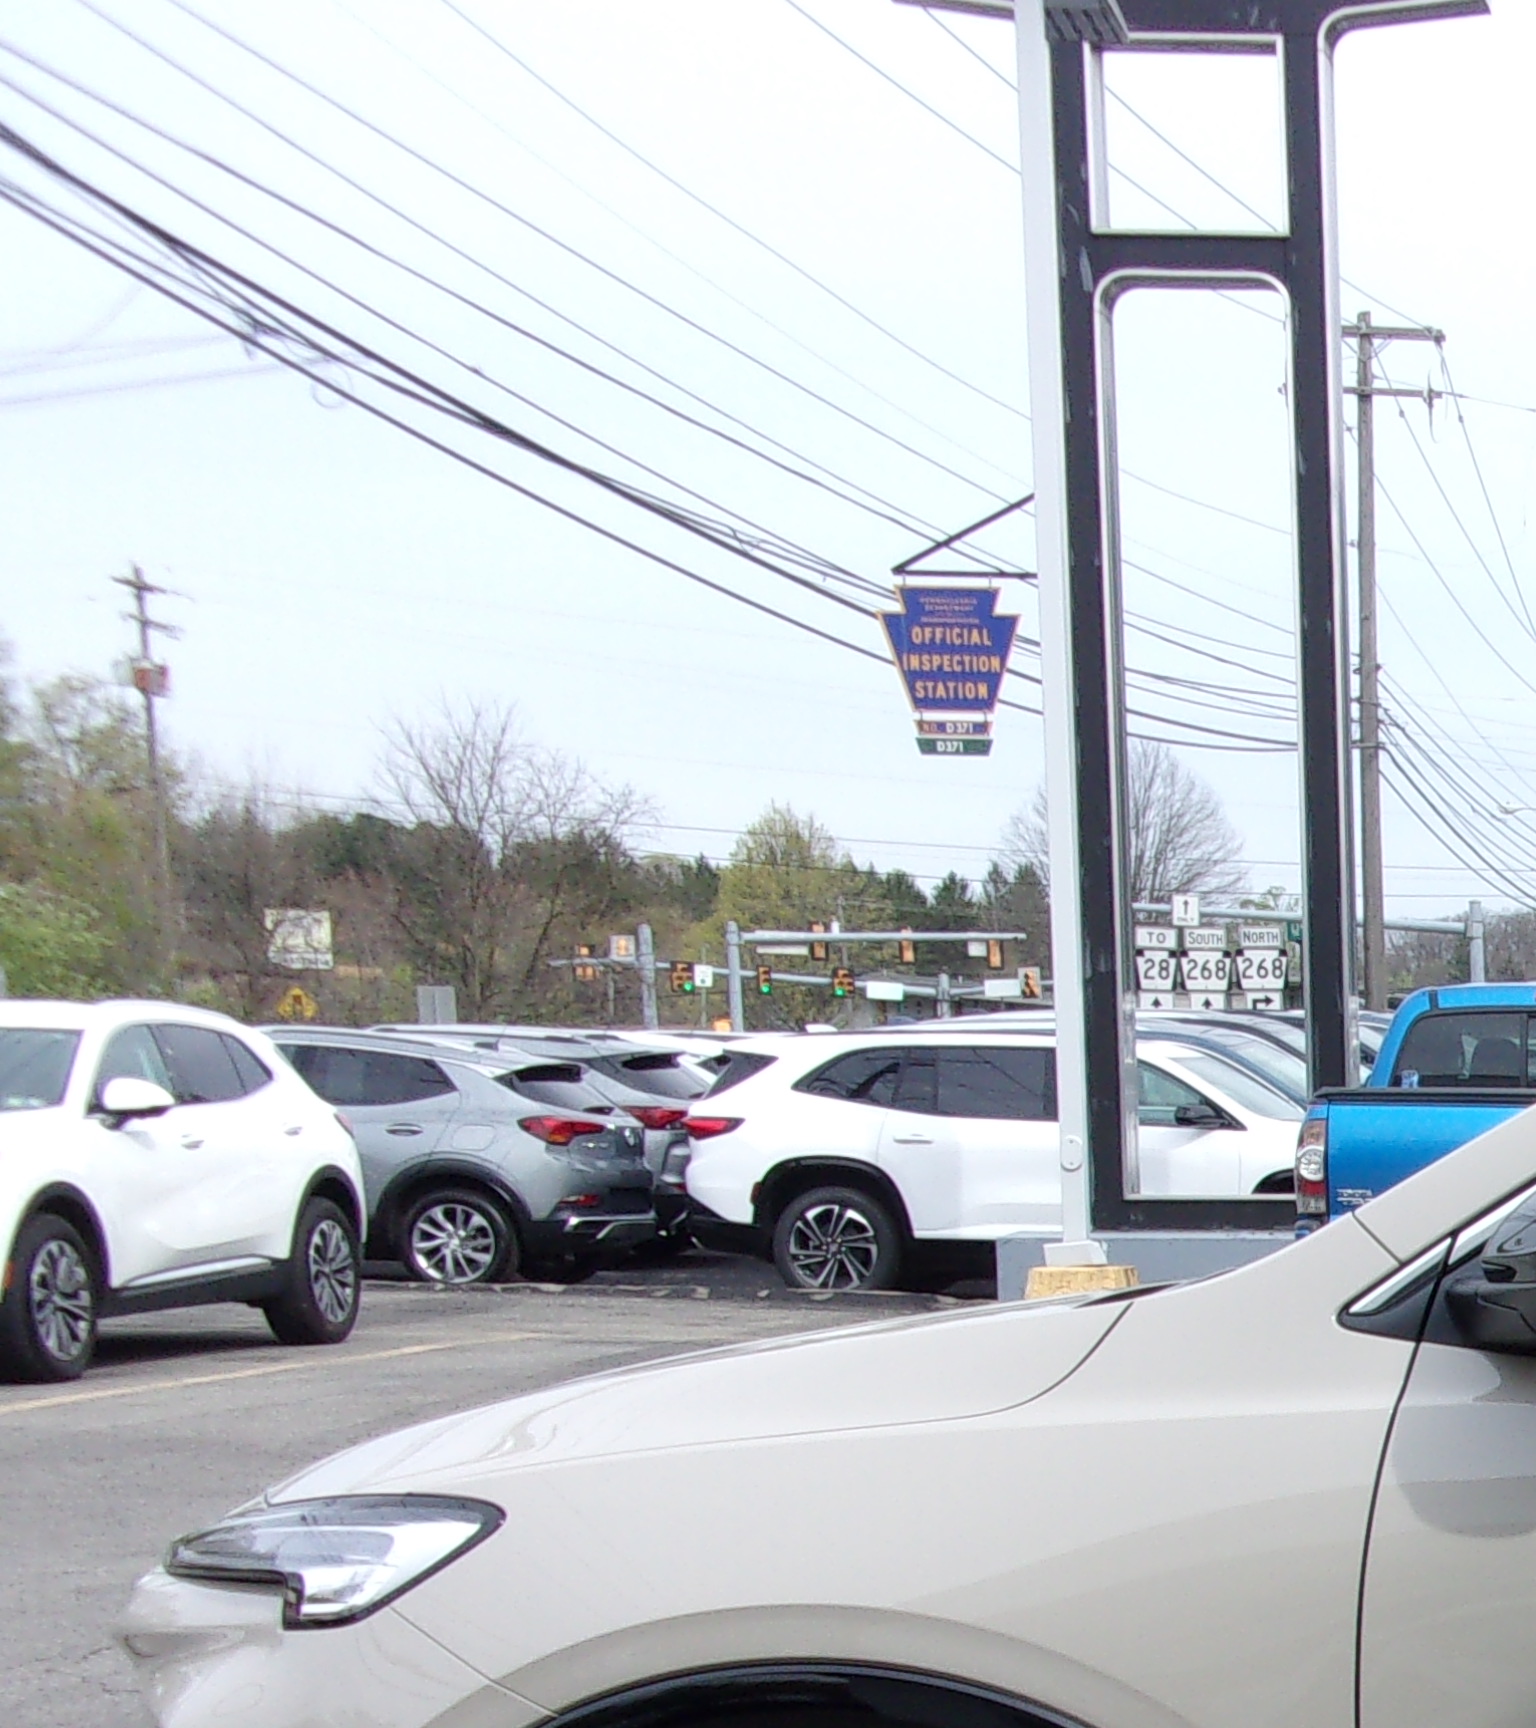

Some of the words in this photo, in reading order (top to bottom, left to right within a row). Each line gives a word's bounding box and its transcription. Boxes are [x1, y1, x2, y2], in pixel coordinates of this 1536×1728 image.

[911, 626, 992, 646] OFFICIAL
[903, 654, 1001, 673] INSPECTION
[914, 681, 989, 699] STATION
[1146, 931, 1166, 944] TO
[1188, 932, 1223, 945] SOUTH
[1243, 931, 1279, 944] NORTH
[1143, 958, 1170, 980] 28
[1186, 959, 1227, 980] 268
[1241, 957, 1283, 979] 268
